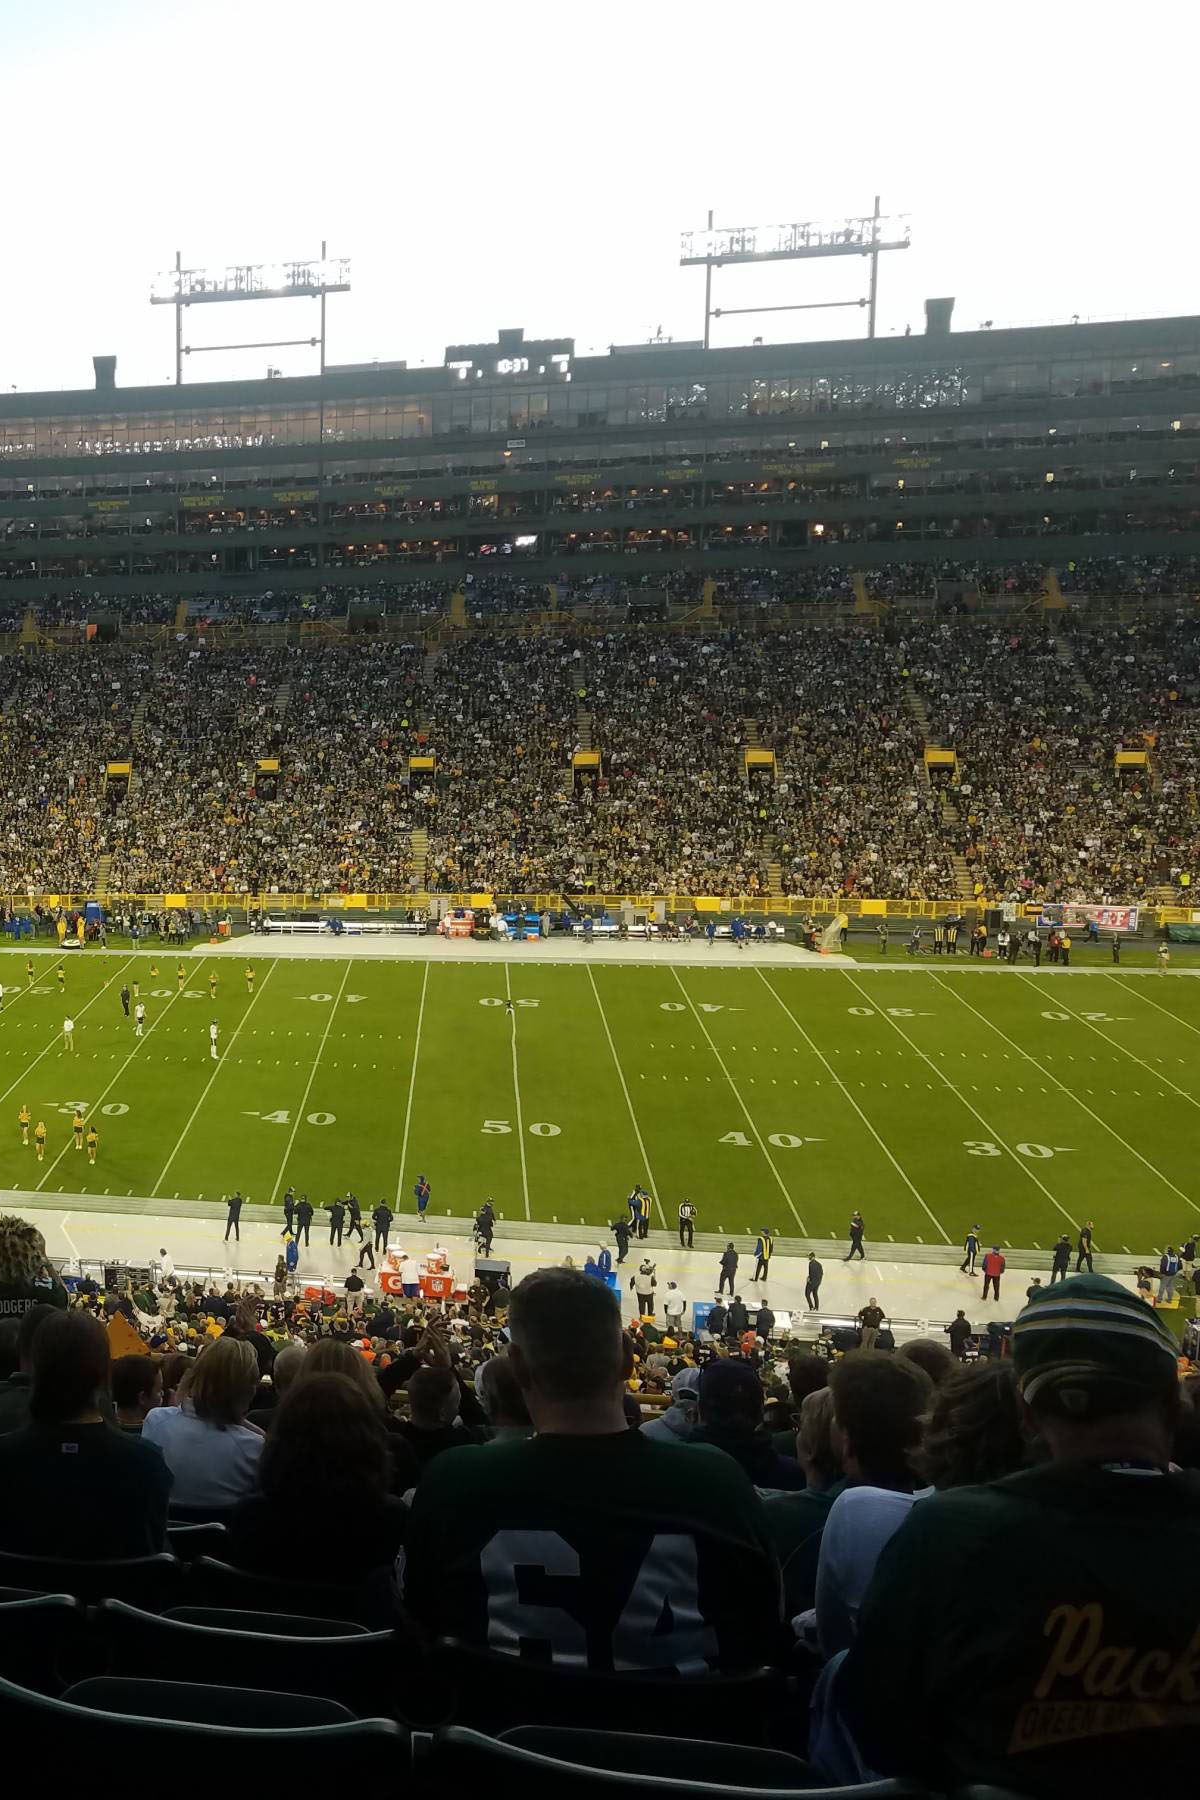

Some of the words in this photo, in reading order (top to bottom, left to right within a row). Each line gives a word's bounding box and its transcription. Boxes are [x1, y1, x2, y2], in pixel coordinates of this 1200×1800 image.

[478, 997, 541, 1008] 50
[659, 1001, 726, 1013] 40
[846, 1006, 915, 1017] 30
[1040, 1010, 1114, 1021] 20
[57, 1101, 130, 1116] 30
[261, 1109, 337, 1126] 40
[480, 1119, 562, 1138] 50
[717, 1130, 804, 1149] 40
[962, 1139, 1055, 1159] 30
[480, 1529, 720, 1681] 64
